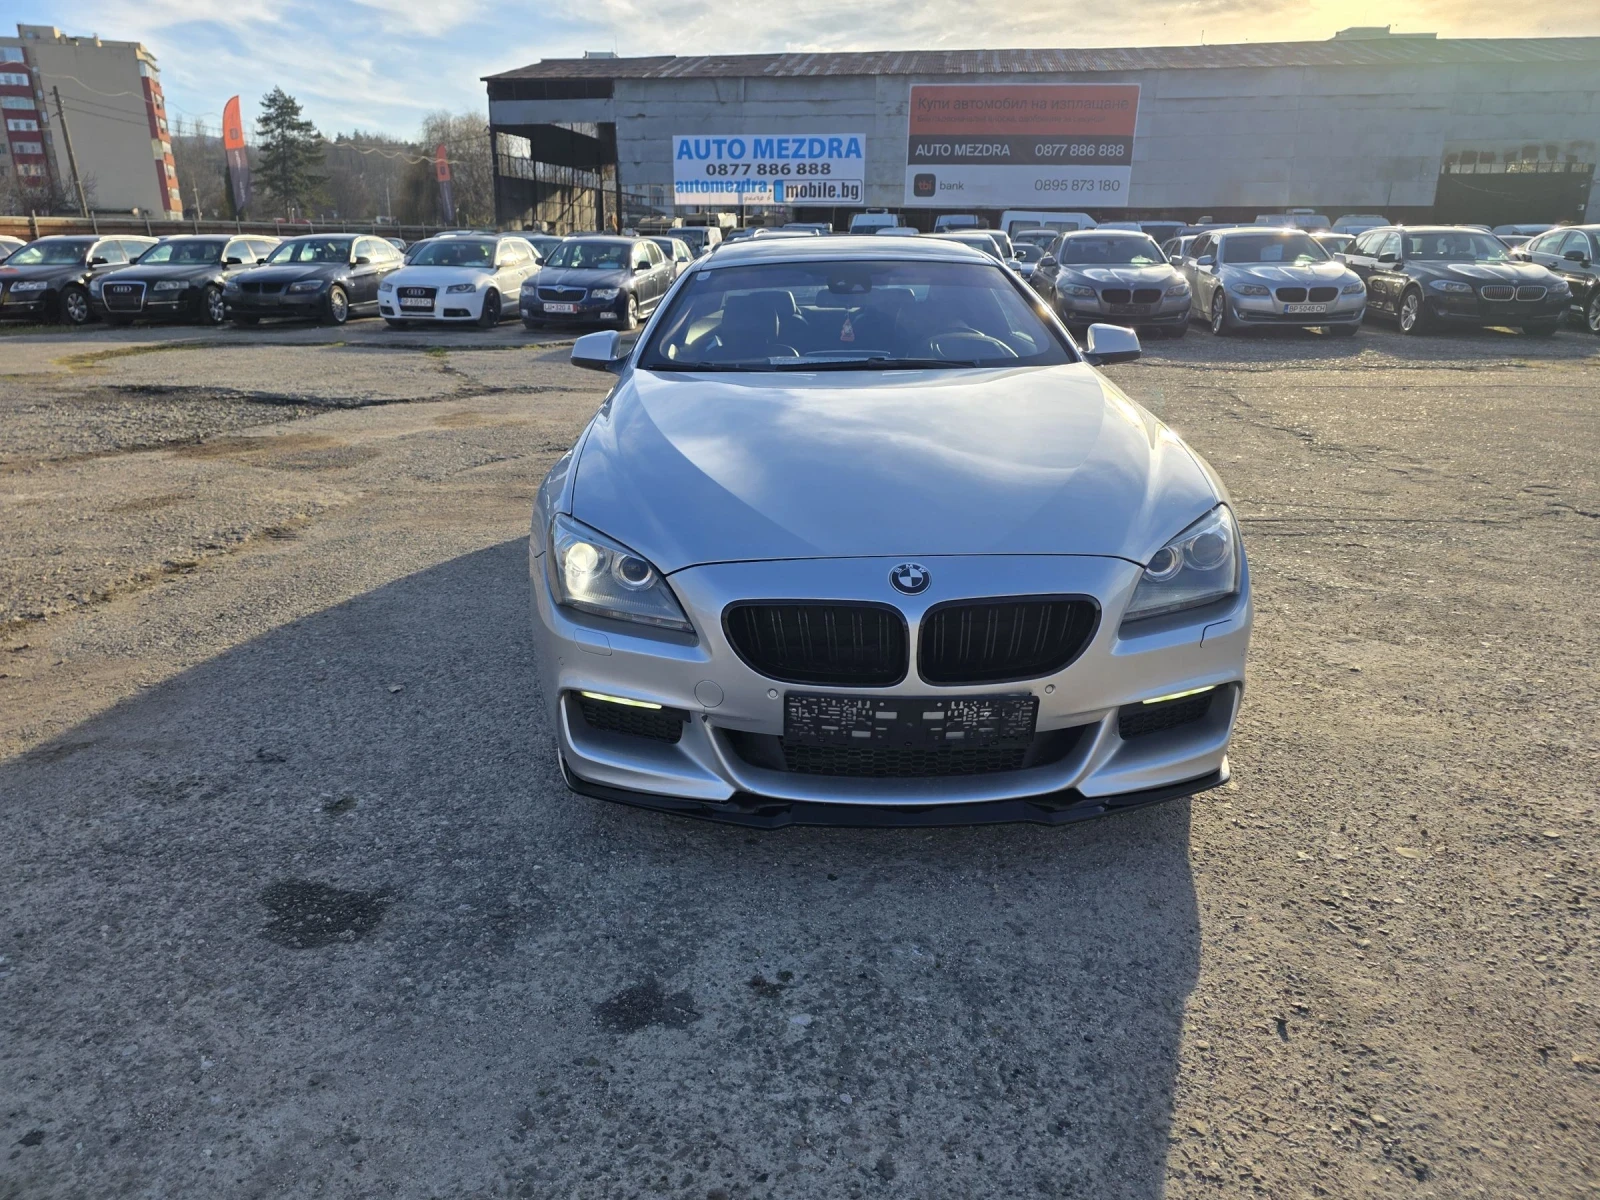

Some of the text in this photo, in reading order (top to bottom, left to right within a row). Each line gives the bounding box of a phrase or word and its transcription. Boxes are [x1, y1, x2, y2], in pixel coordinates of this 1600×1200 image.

[917, 97, 1128, 112] Купи автомобил на изплащане
[676, 137, 862, 160] AUTO MEZDRA
[915, 144, 1011, 157] AUTO MEZDRA
[1035, 144, 1124, 157] 0877 886 888
[706, 163, 831, 176] 0877 886 888
[785, 182, 859, 200] mobile.bg
[939, 181, 964, 191] bank
[1034, 179, 1121, 192] 0895 873 180
[894, 564, 927, 574] BMW
